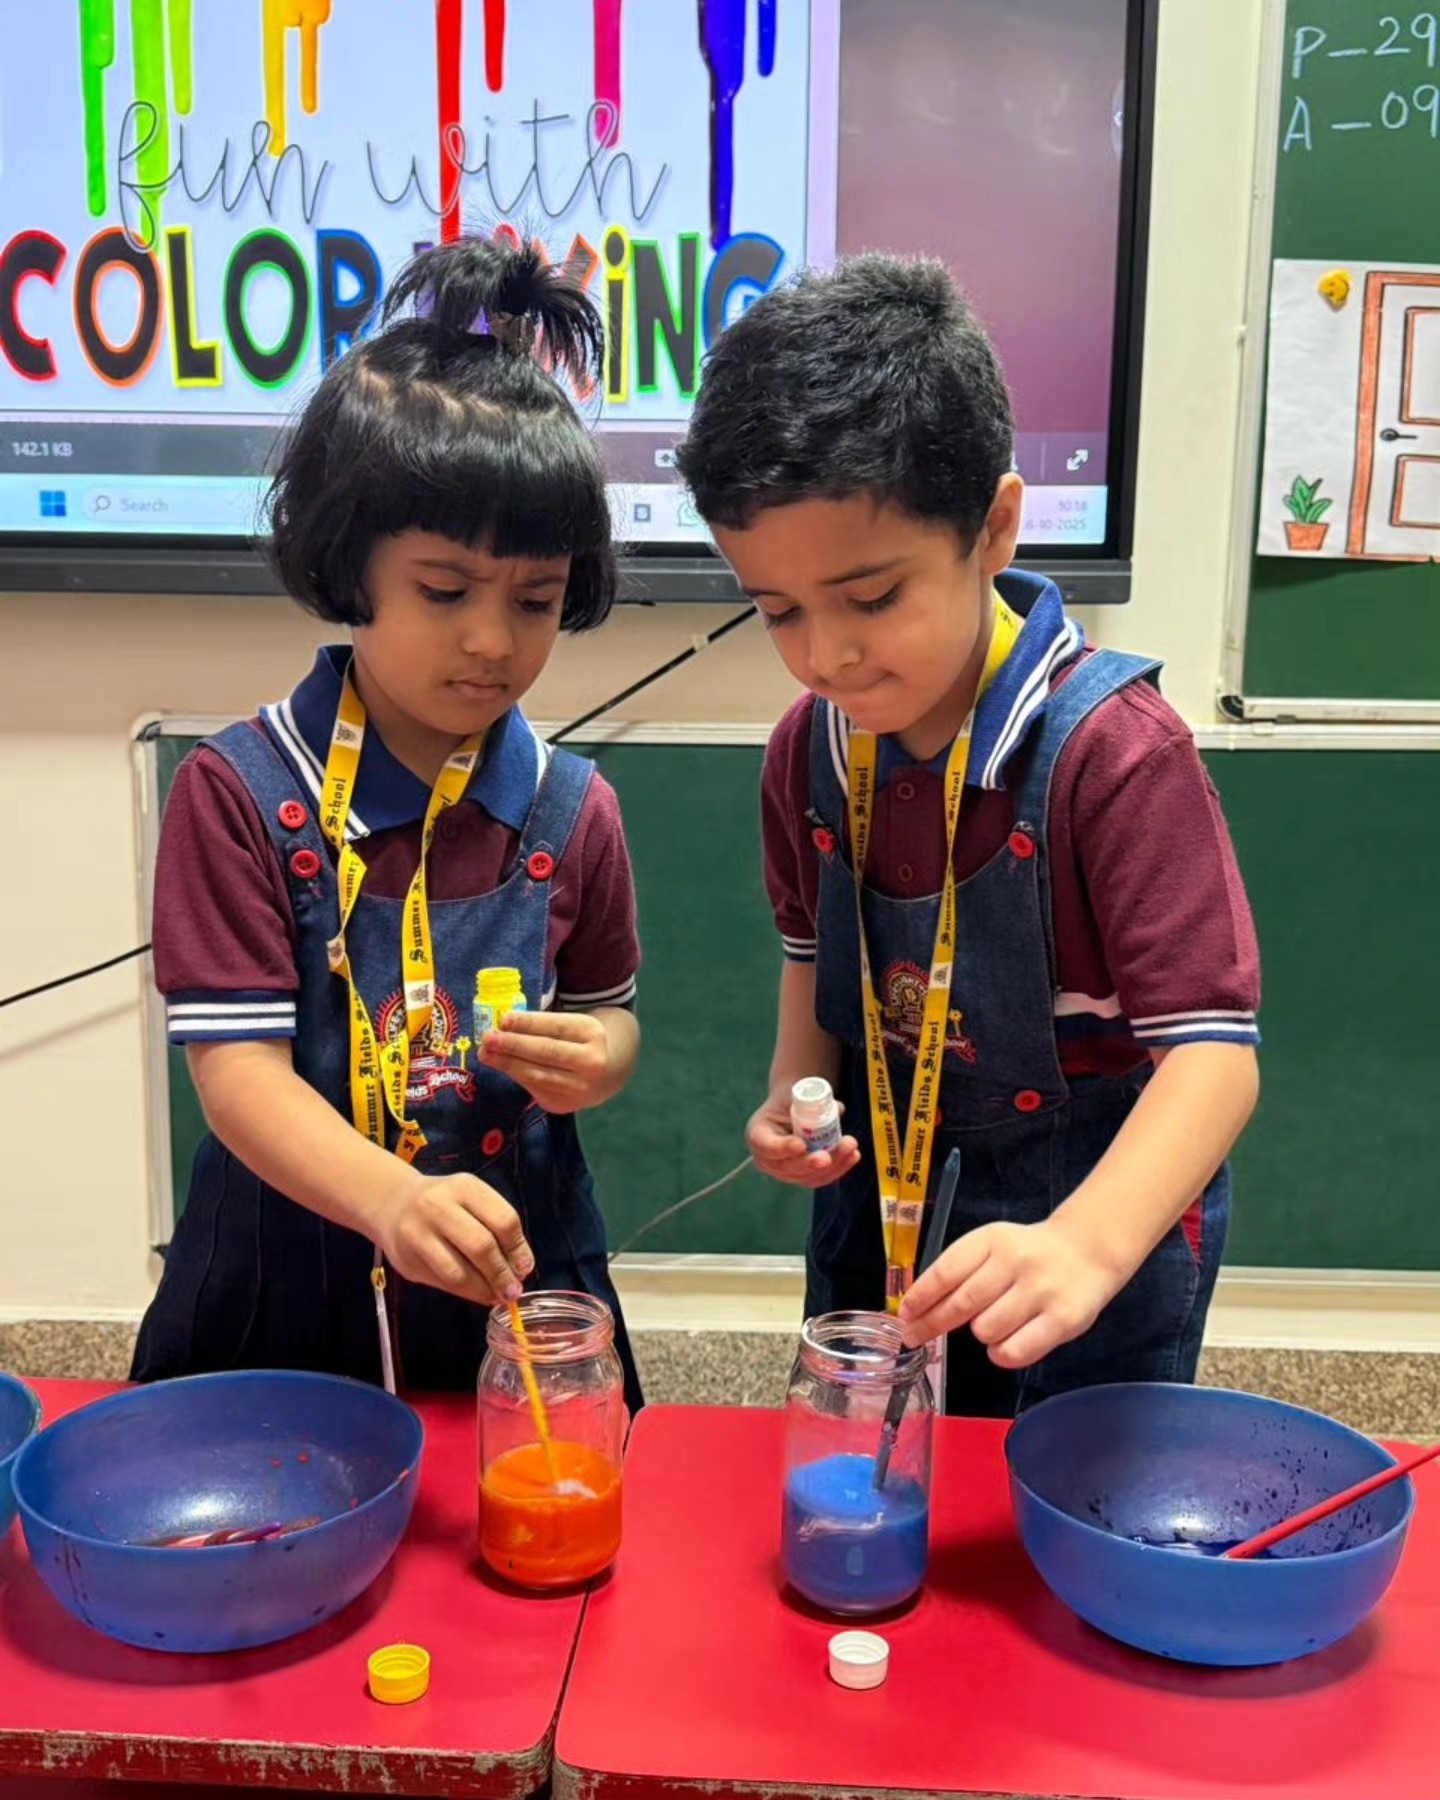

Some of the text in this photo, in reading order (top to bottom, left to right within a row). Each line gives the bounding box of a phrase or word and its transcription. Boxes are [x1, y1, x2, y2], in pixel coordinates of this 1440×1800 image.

[118, 98, 669, 253] fun with
[0, 224, 383, 388] COLOR
[12, 442, 73, 457] 142.1 KB
[120, 496, 168, 512] Search
[325, 777, 346, 832] School
[855, 767, 869, 819] School
[409, 901, 428, 963] Summer
[359, 1027, 378, 1079] Fields
[867, 1013, 900, 1180] Summer Fields School
[906, 1021, 939, 1187] Summer Fields School
